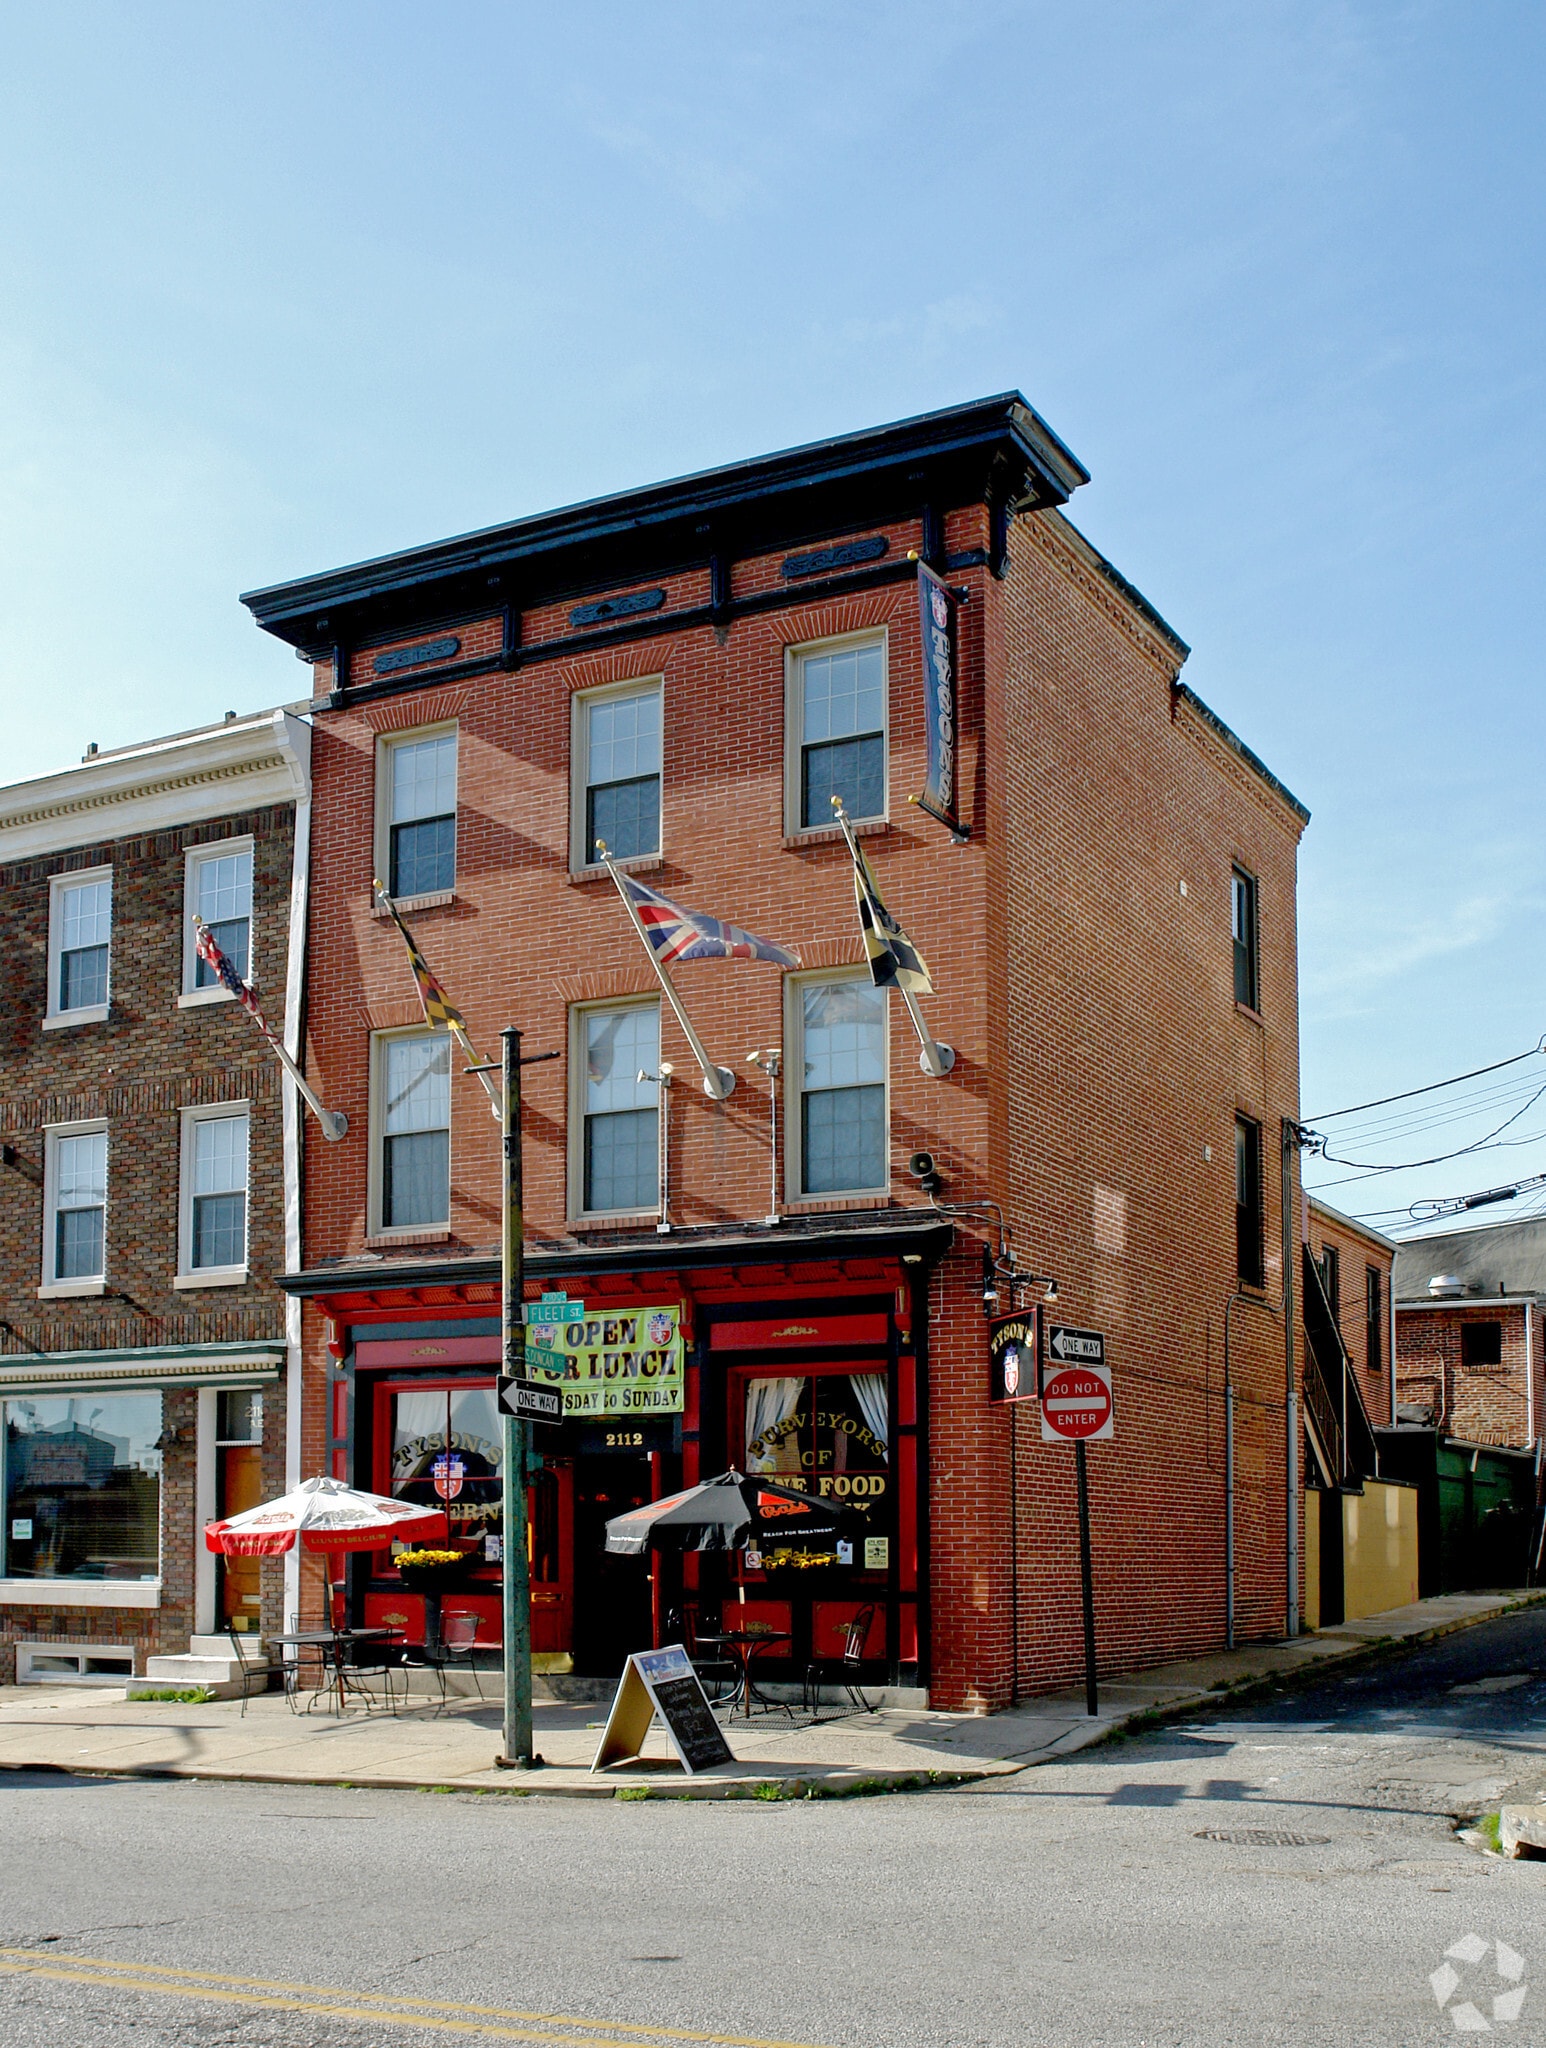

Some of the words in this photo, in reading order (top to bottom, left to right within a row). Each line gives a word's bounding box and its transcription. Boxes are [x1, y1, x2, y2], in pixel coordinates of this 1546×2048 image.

[531, 1305, 566, 1321] FLEET
[569, 1307, 582, 1317] ST.
[566, 1317, 638, 1348] OPEN
[990, 1322, 1034, 1355] TYSON'S
[1061, 1337, 1079, 1353] ONE
[1082, 1341, 1100, 1356] WAY
[588, 1350, 677, 1380] LUNCH
[603, 1392, 617, 1408] to
[623, 1388, 679, 1408] SUNDAY
[1051, 1383, 1069, 1395] DO
[1074, 1382, 1100, 1394] NOT
[518, 1390, 537, 1407] ONE
[538, 1393, 557, 1411] WAY
[1057, 1414, 1097, 1426] ENTER
[606, 1432, 643, 1447] 2112
[748, 1411, 889, 1460] PURVEYORS
[393, 1430, 504, 1468] TYSON'S
[801, 1449, 833, 1467] OF
[819, 1476, 887, 1497] FOOD
[759, 1501, 812, 1519] Bass
